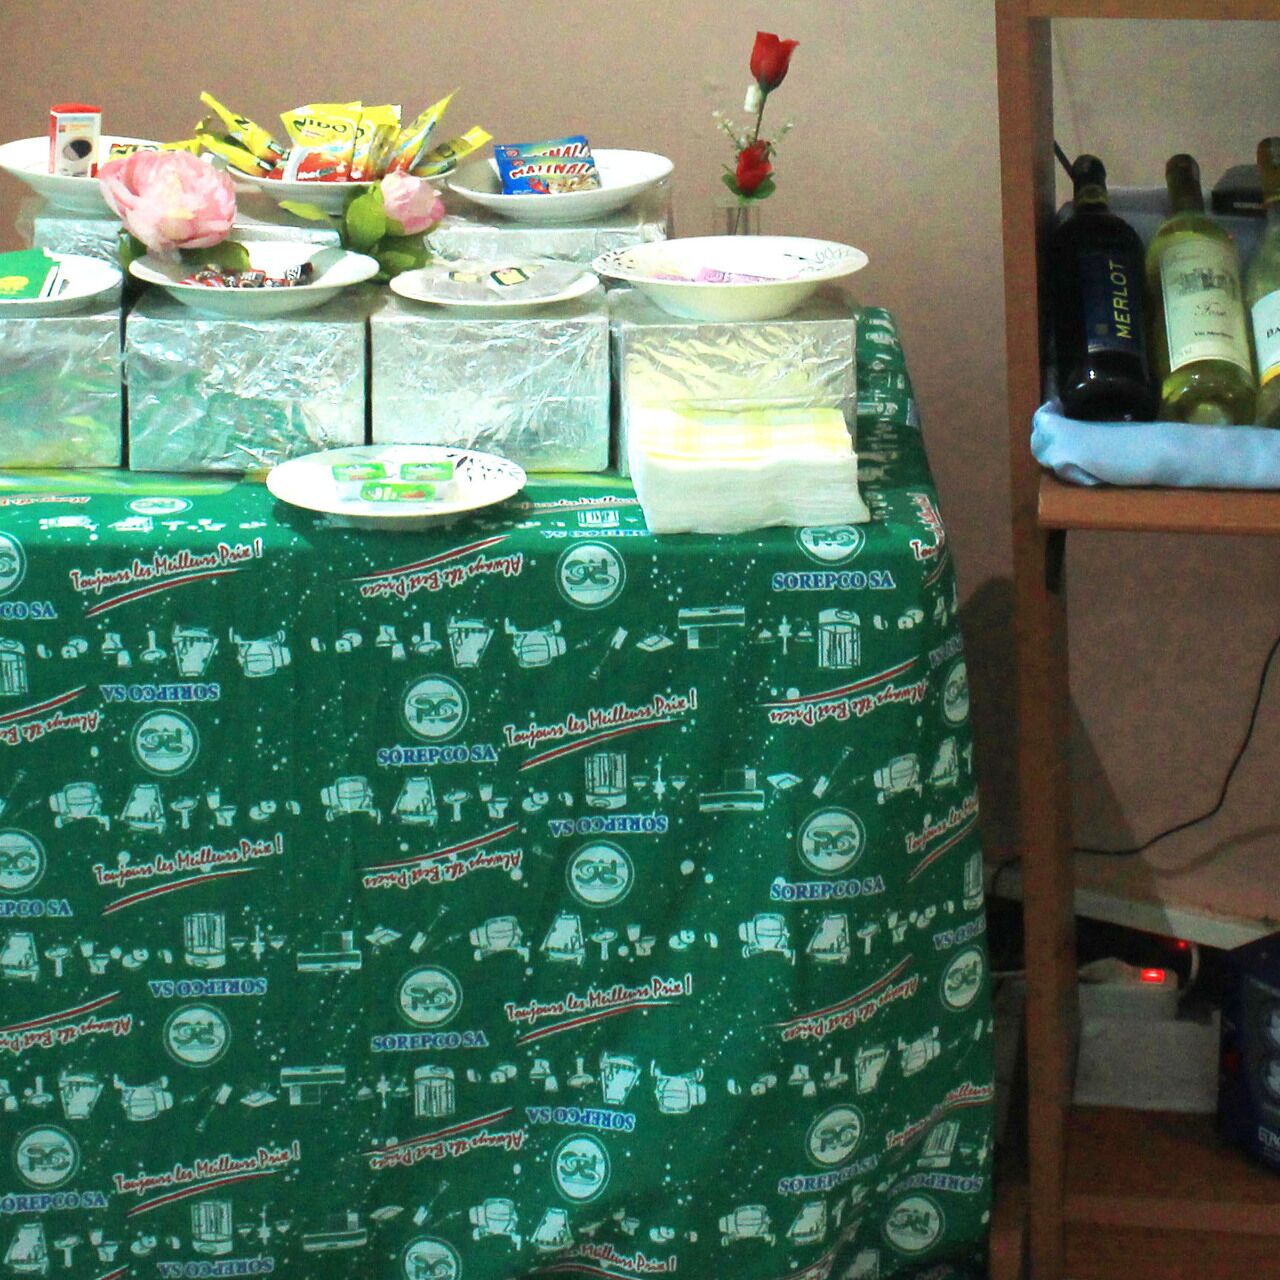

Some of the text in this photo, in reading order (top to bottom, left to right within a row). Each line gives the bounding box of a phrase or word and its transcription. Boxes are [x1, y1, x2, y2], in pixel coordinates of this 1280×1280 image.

[293, 118, 347, 133] NIDO
[1109, 258, 1132, 339] MERLOT
[70, 569, 131, 594] Toujours
[131, 558, 153, 580] les
[153, 550, 217, 576] Meilleurs
[218, 543, 252, 565] Prix
[360, 553, 522, 600] Always the Best Prices
[772, 571, 896, 592] SOREPCO SA
[30, 602, 58, 620] SA
[99, 683, 220, 702] SOREPCO SA
[875, 681, 928, 706] Always
[816, 700, 849, 720] Best
[850, 695, 875, 716] the
[21, 721, 44, 741] the
[46, 712, 99, 733] Always
[504, 725, 565, 749] Toujours
[566, 714, 586, 734] les
[587, 703, 653, 730] Meilleurs
[654, 695, 688, 719] Prix
[377, 745, 498, 766] SOREPCO SA
[548, 815, 669, 837] SOREPCO SA
[93, 864, 153, 887] Toujours
[155, 854, 174, 875] les
[175, 846, 239, 871] Meilleurs
[240, 839, 273, 862] Prix
[443, 862, 466, 880] the
[468, 850, 522, 871] Always
[410, 865, 441, 884] Best
[770, 876, 886, 902] SOREPCO SA
[46, 899, 74, 917] SA
[148, 978, 267, 998] SOREPCO SA
[504, 1000, 564, 1025] Toujours
[565, 993, 584, 1010] les
[586, 985, 649, 1007] Meilleurs
[650, 976, 683, 998] Prix
[56, 1025, 78, 1043] the
[79, 1014, 131, 1035] Always
[22, 1028, 54, 1048] Best
[371, 1030, 489, 1051] SOREPCO SA
[526, 1107, 636, 1132] SOREPCO SA
[448, 1138, 470, 1158] the
[472, 1130, 525, 1151] Always
[415, 1142, 445, 1161] Best
[113, 1173, 174, 1195] Toujours
[175, 1163, 193, 1183] les
[194, 1153, 257, 1179] Meilleurs
[257, 1147, 290, 1169] Prix
[82, 1191, 108, 1209] SA
[634, 1251, 666, 1273] Prix
